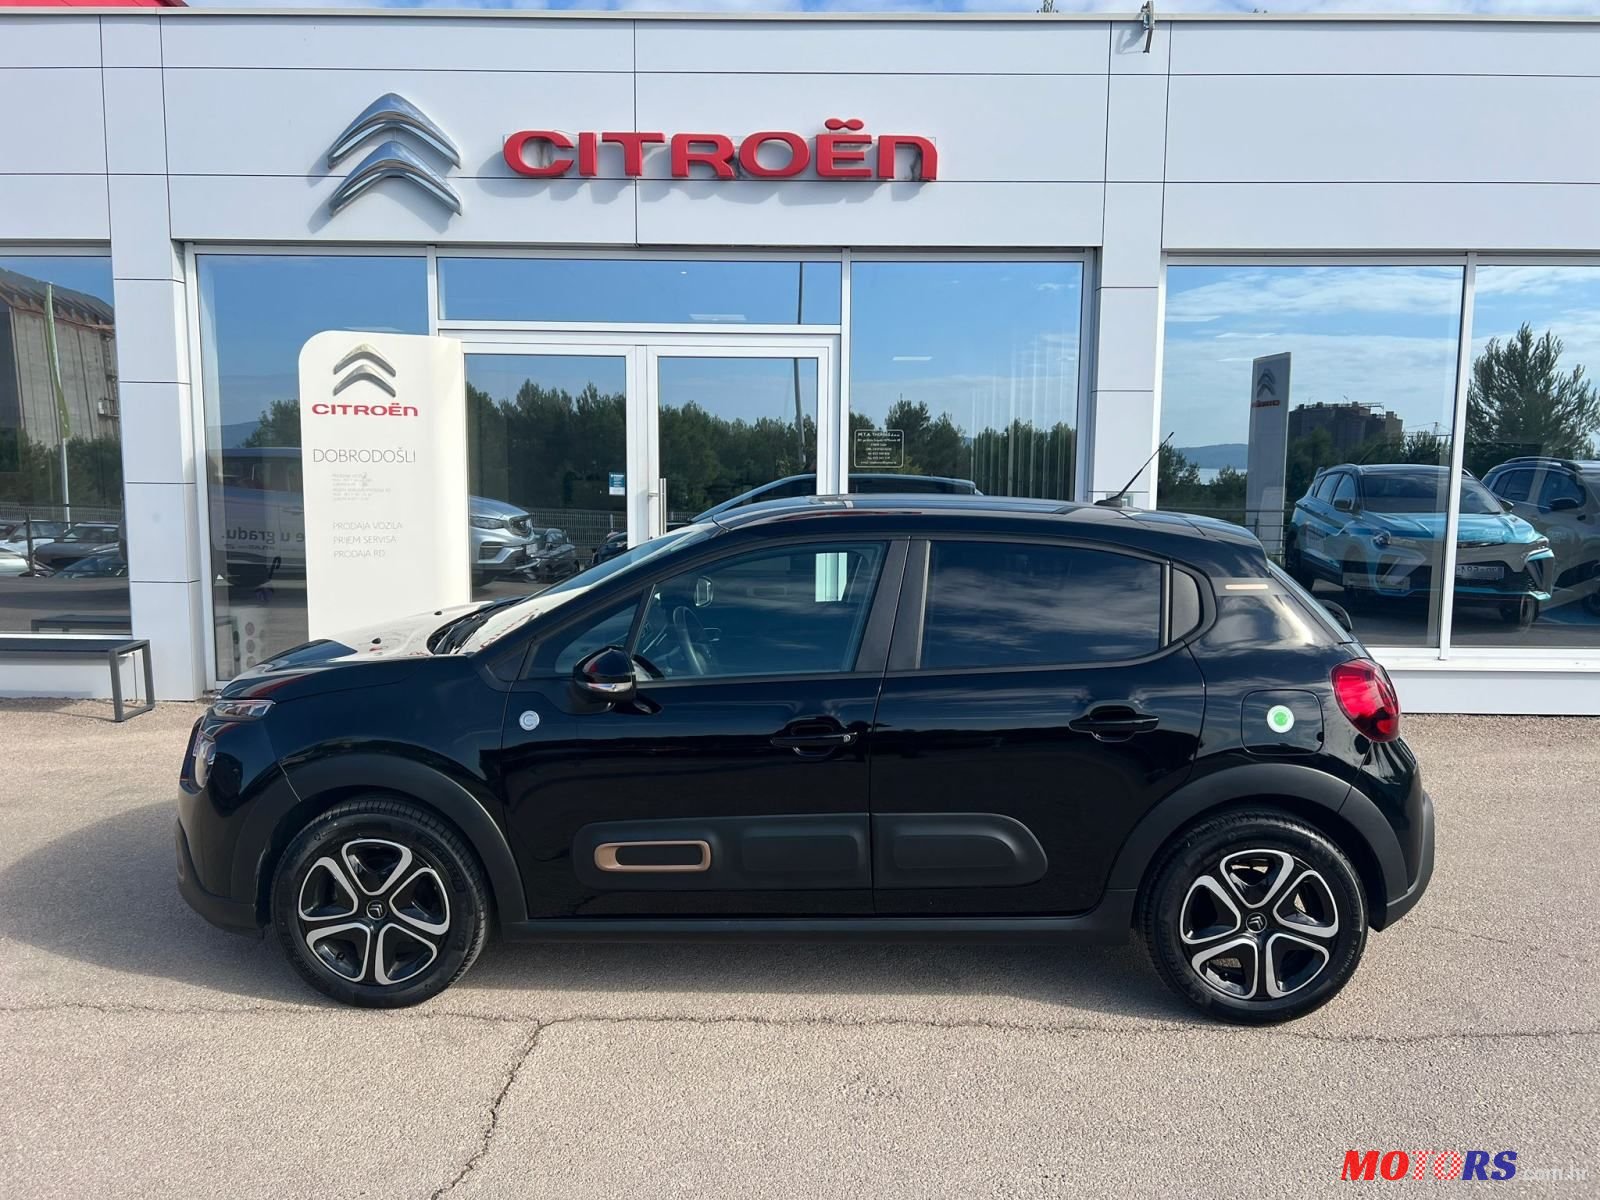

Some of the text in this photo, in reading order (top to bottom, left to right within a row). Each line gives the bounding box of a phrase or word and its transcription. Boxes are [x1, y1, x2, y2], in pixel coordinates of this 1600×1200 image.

[313, 447, 416, 463] DOBRODOŠLI
[333, 521, 403, 530] PRODAJA VOZILA
[363, 535, 397, 544] SERVISA
[334, 549, 371, 558] PRODAJA
